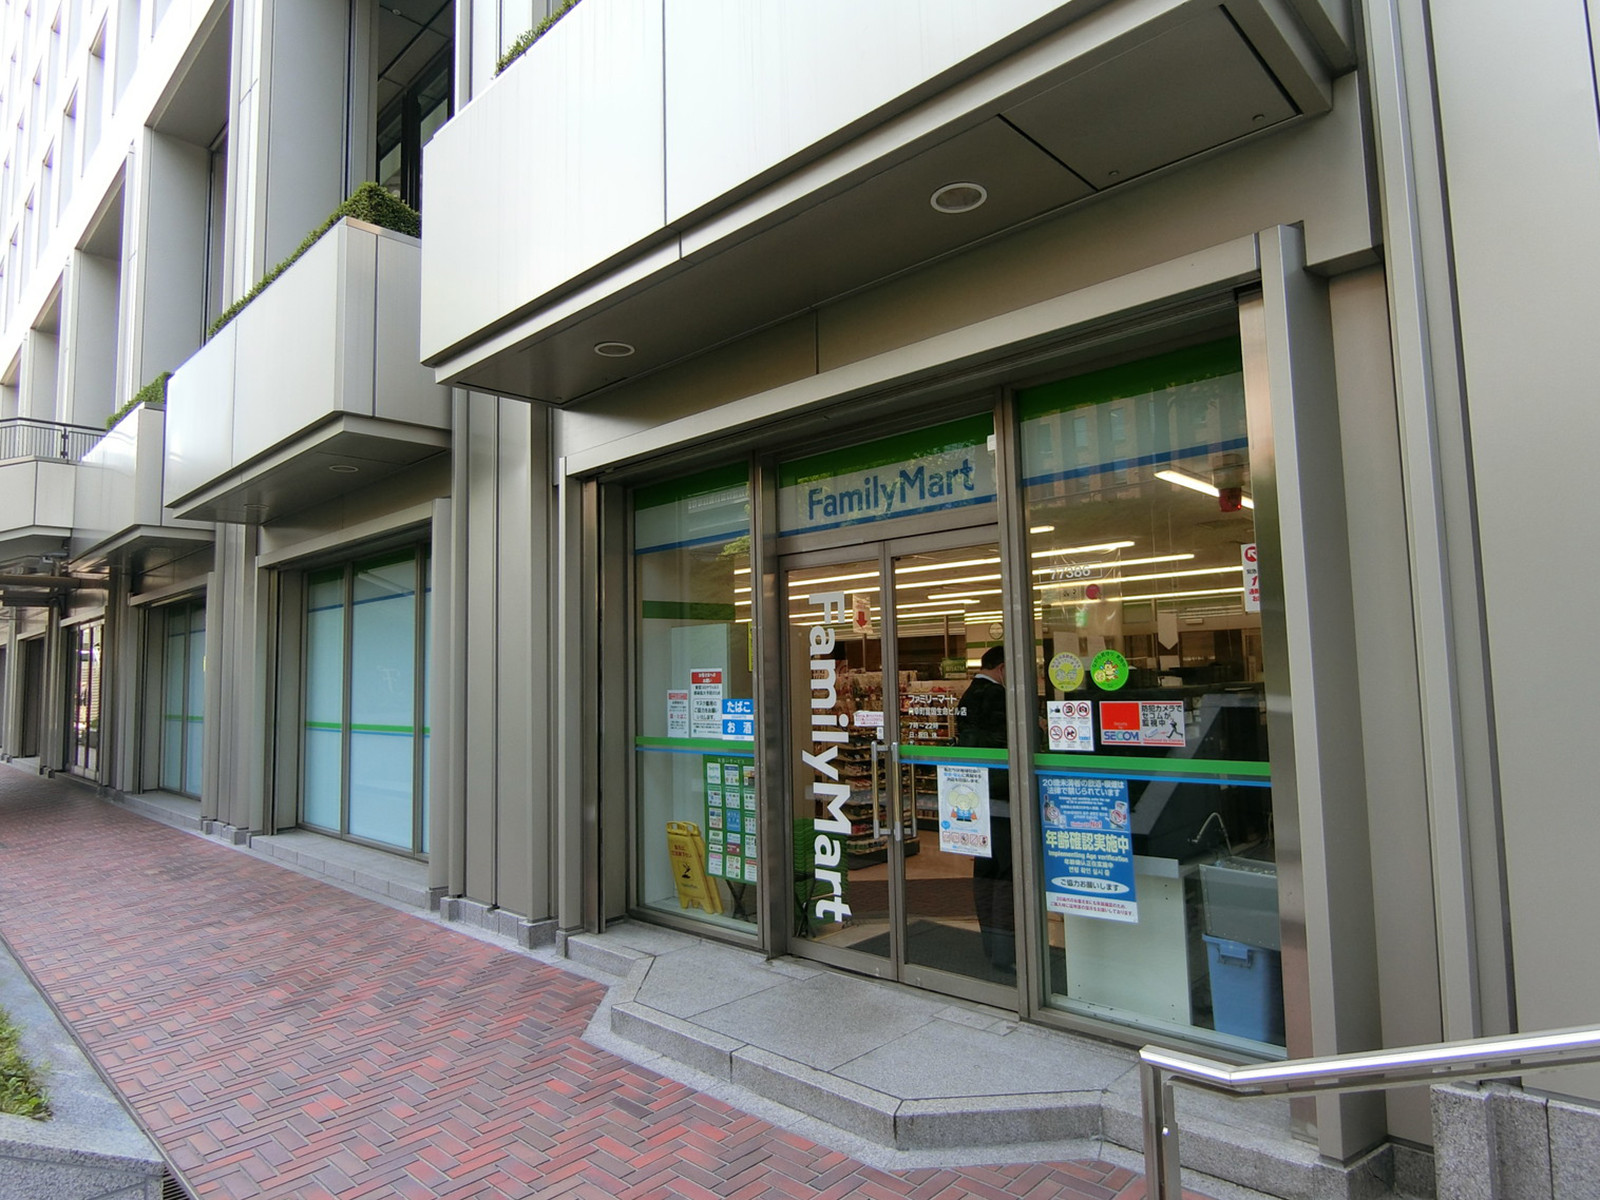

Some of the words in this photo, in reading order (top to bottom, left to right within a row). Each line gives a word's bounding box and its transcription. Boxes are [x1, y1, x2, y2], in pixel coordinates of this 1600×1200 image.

[808, 458, 975, 520] FamilyMart
[908, 694, 957, 704] ファミリーマート
[727, 701, 751, 713] たばこ
[1142, 705, 1182, 713] 防犯カメラで
[1142, 720, 1166, 728] 監視中
[1104, 731, 1139, 741] SECOM
[801, 590, 852, 923] FamilyMart
[1047, 787, 1121, 797] 法律で禁じられています
[1045, 830, 1129, 854] 年齢確認実施中
[1060, 879, 1119, 891] ご協力お願いします
